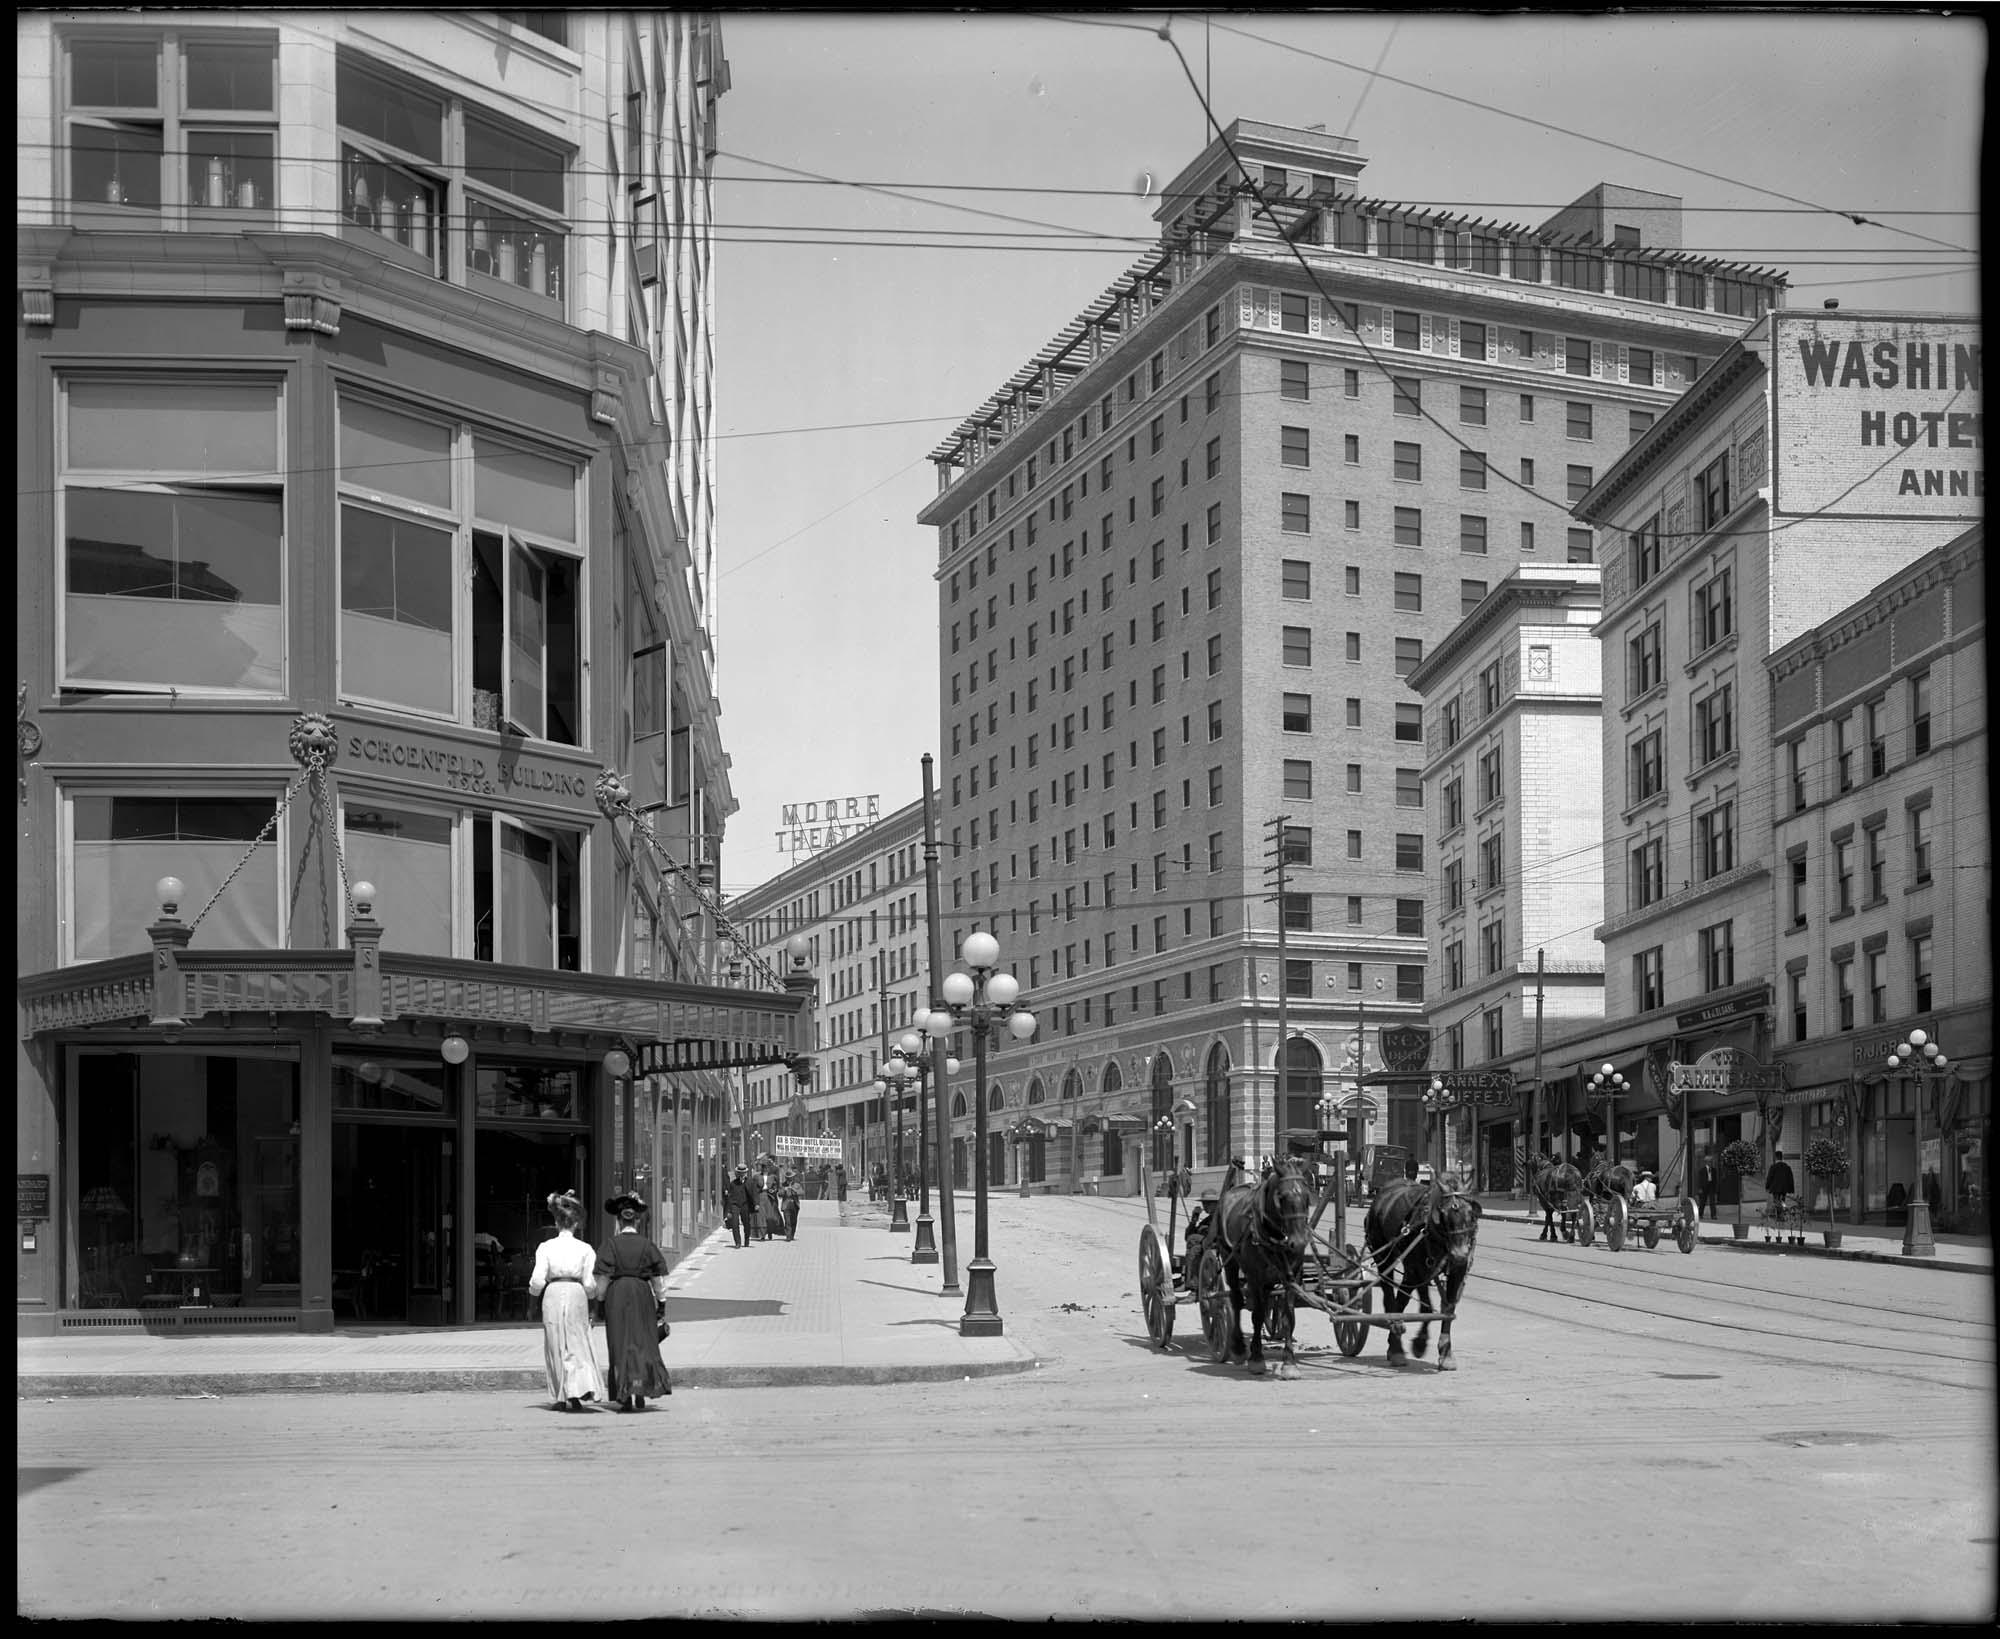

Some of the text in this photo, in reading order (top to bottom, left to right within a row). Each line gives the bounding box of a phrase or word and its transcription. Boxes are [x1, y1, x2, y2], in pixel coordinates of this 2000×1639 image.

[1798, 339, 1980, 390] WASHIN
[349, 736, 585, 797] SCHOENFELD BUILDING
[782, 794, 880, 825] MOORE
[1445, 1075, 1499, 1088] ANNEX
